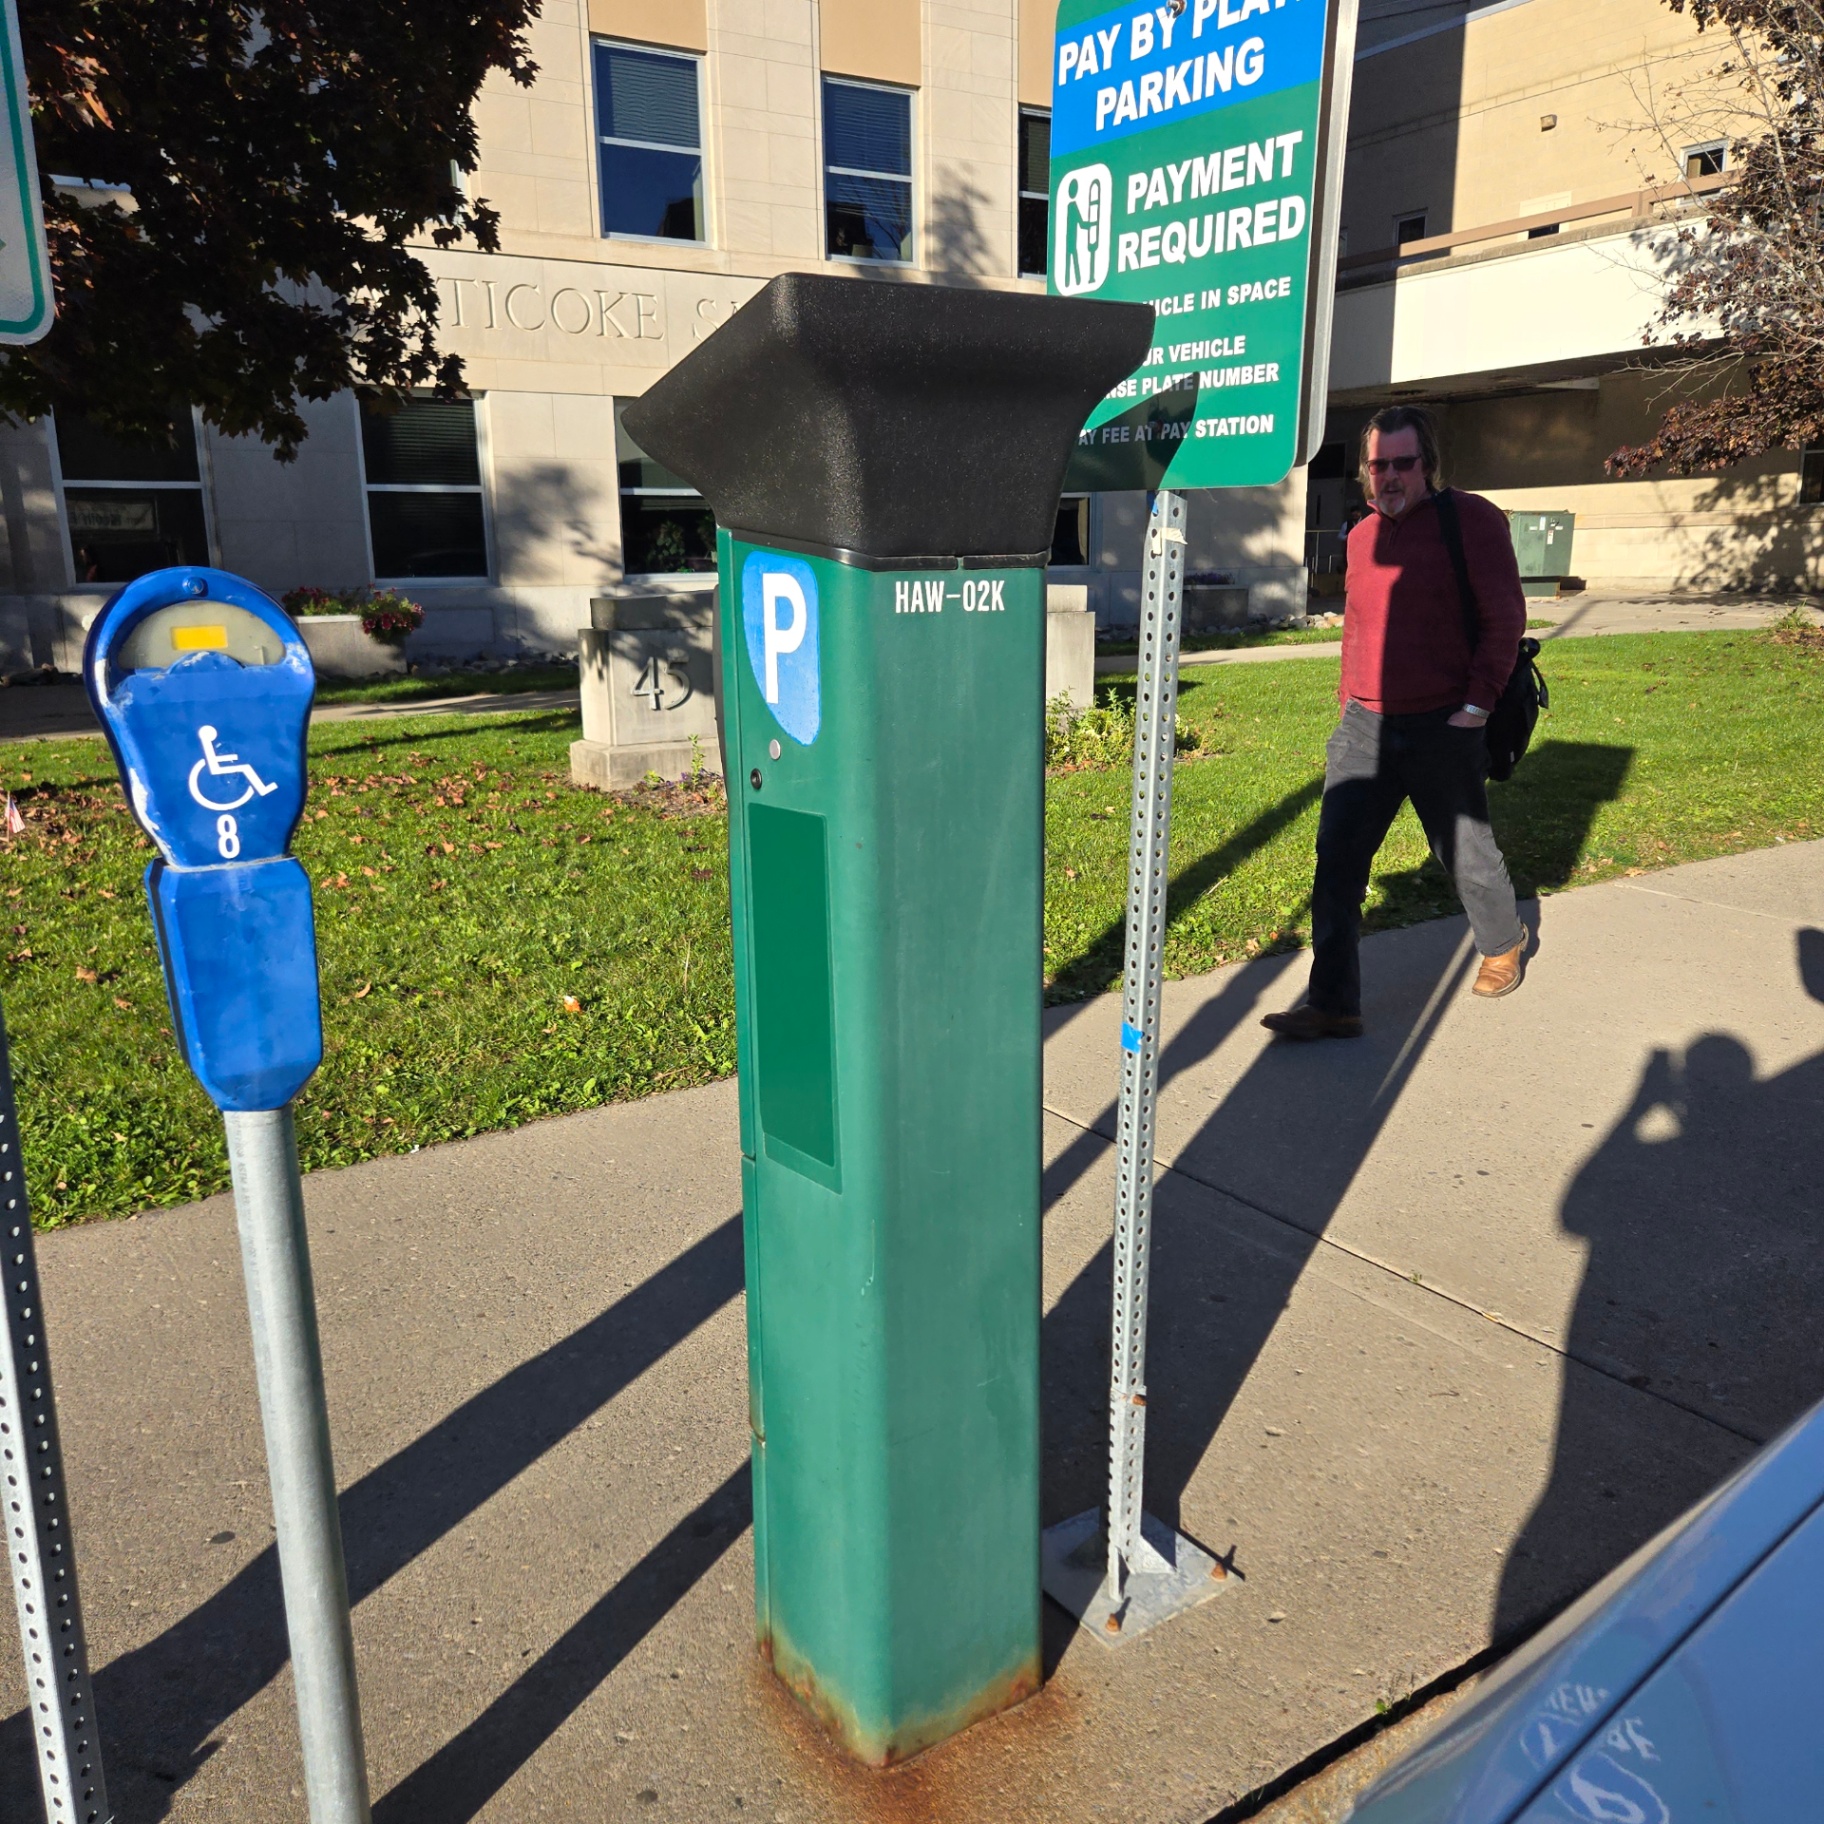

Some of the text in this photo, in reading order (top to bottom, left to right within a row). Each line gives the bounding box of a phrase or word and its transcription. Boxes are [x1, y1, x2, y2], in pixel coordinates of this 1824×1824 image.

[1058, 23, 1122, 86] PAY
[1130, 6, 1177, 61] BY
[1096, 36, 1265, 132] PARKING
[1127, 130, 1303, 215] PAYMENT
[1117, 195, 1306, 273] REQUIRED
[1201, 289, 1221, 310] IN
[1227, 276, 1291, 306] SPACE
[1168, 335, 1246, 363] VEHICLE
[1142, 372, 1194, 395] PLATE
[1199, 363, 1279, 389] NUMBER
[1102, 426, 1130, 444] FEE
[1134, 421, 1156, 442] AT
[1160, 421, 1191, 440] PAY
[1195, 414, 1274, 438] STATION
[895, 580, 1005, 614] HAW-02K
[762, 572, 807, 704] P
[631, 654, 692, 711] 45
[216, 814, 241, 859] 8
